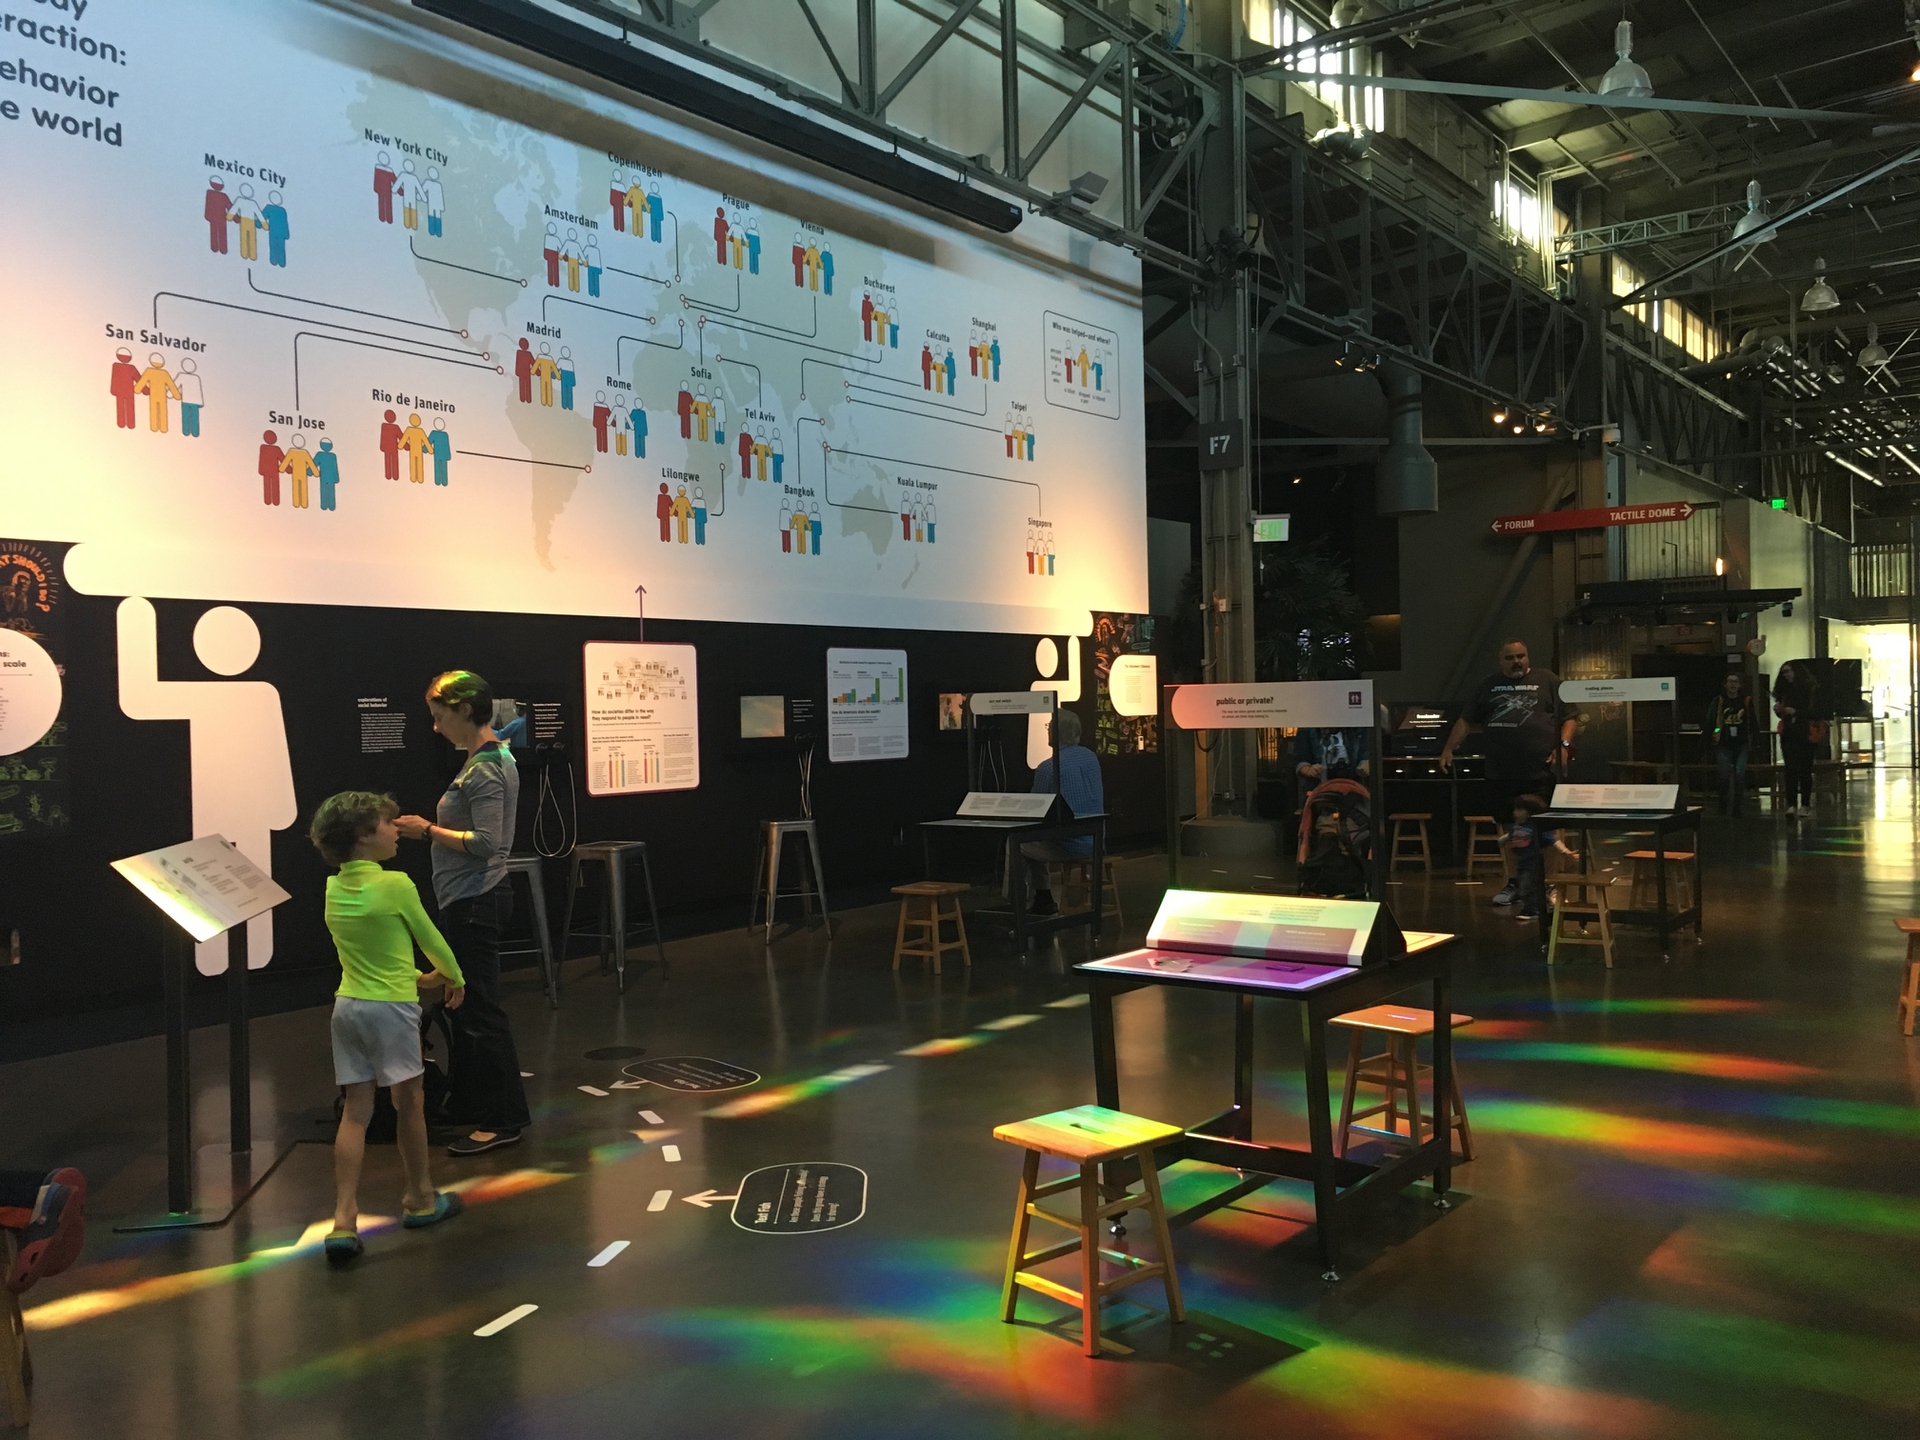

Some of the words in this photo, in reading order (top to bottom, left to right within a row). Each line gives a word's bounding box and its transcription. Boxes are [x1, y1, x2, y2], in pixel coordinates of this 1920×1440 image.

[0, 13, 126, 66] raction:
[31, 107, 122, 147] world
[364, 128, 391, 146] New
[395, 136, 422, 157] York
[425, 146, 449, 167] City
[204, 153, 255, 179] Mexico
[259, 168, 286, 189] City
[608, 151, 663, 178] Copenhagen
[722, 192, 750, 211] Prague
[544, 204, 599, 230] Amsterdam
[800, 218, 825, 235] Vienna
[863, 276, 896, 294] Bucharest
[526, 321, 562, 340] Madrid
[971, 317, 997, 332] Shanghai
[105, 324, 135, 343] San
[140, 329, 207, 354] Salvador
[926, 329, 950, 344] Calcutta
[690, 366, 712, 381] Sofia
[606, 375, 632, 392] Rome
[372, 388, 392, 405] Rio
[396, 392, 411, 408] de
[414, 394, 456, 415] Janeiro
[1011, 400, 1027, 413] Taipei
[268, 410, 294, 428] San
[298, 414, 325, 432] Jose
[745, 408, 757, 420] Tel
[758, 410, 776, 424] Aviv
[1209, 434, 1231, 455] F7
[662, 467, 701, 483] Lilongwe
[784, 484, 816, 499] Bangkok
[897, 476, 914, 489] Kuala
[915, 478, 938, 492] Lumpur
[1609, 509, 1646, 521] TACTILE
[1648, 507, 1676, 518] DOME
[1027, 516, 1053, 530] Singapore
[1261, 521, 1282, 540] EXIT
[1504, 519, 1535, 530] FORUM
[3, 660, 27, 668] scale
[1216, 697, 1236, 706] public
[1246, 696, 1274, 706] private?
